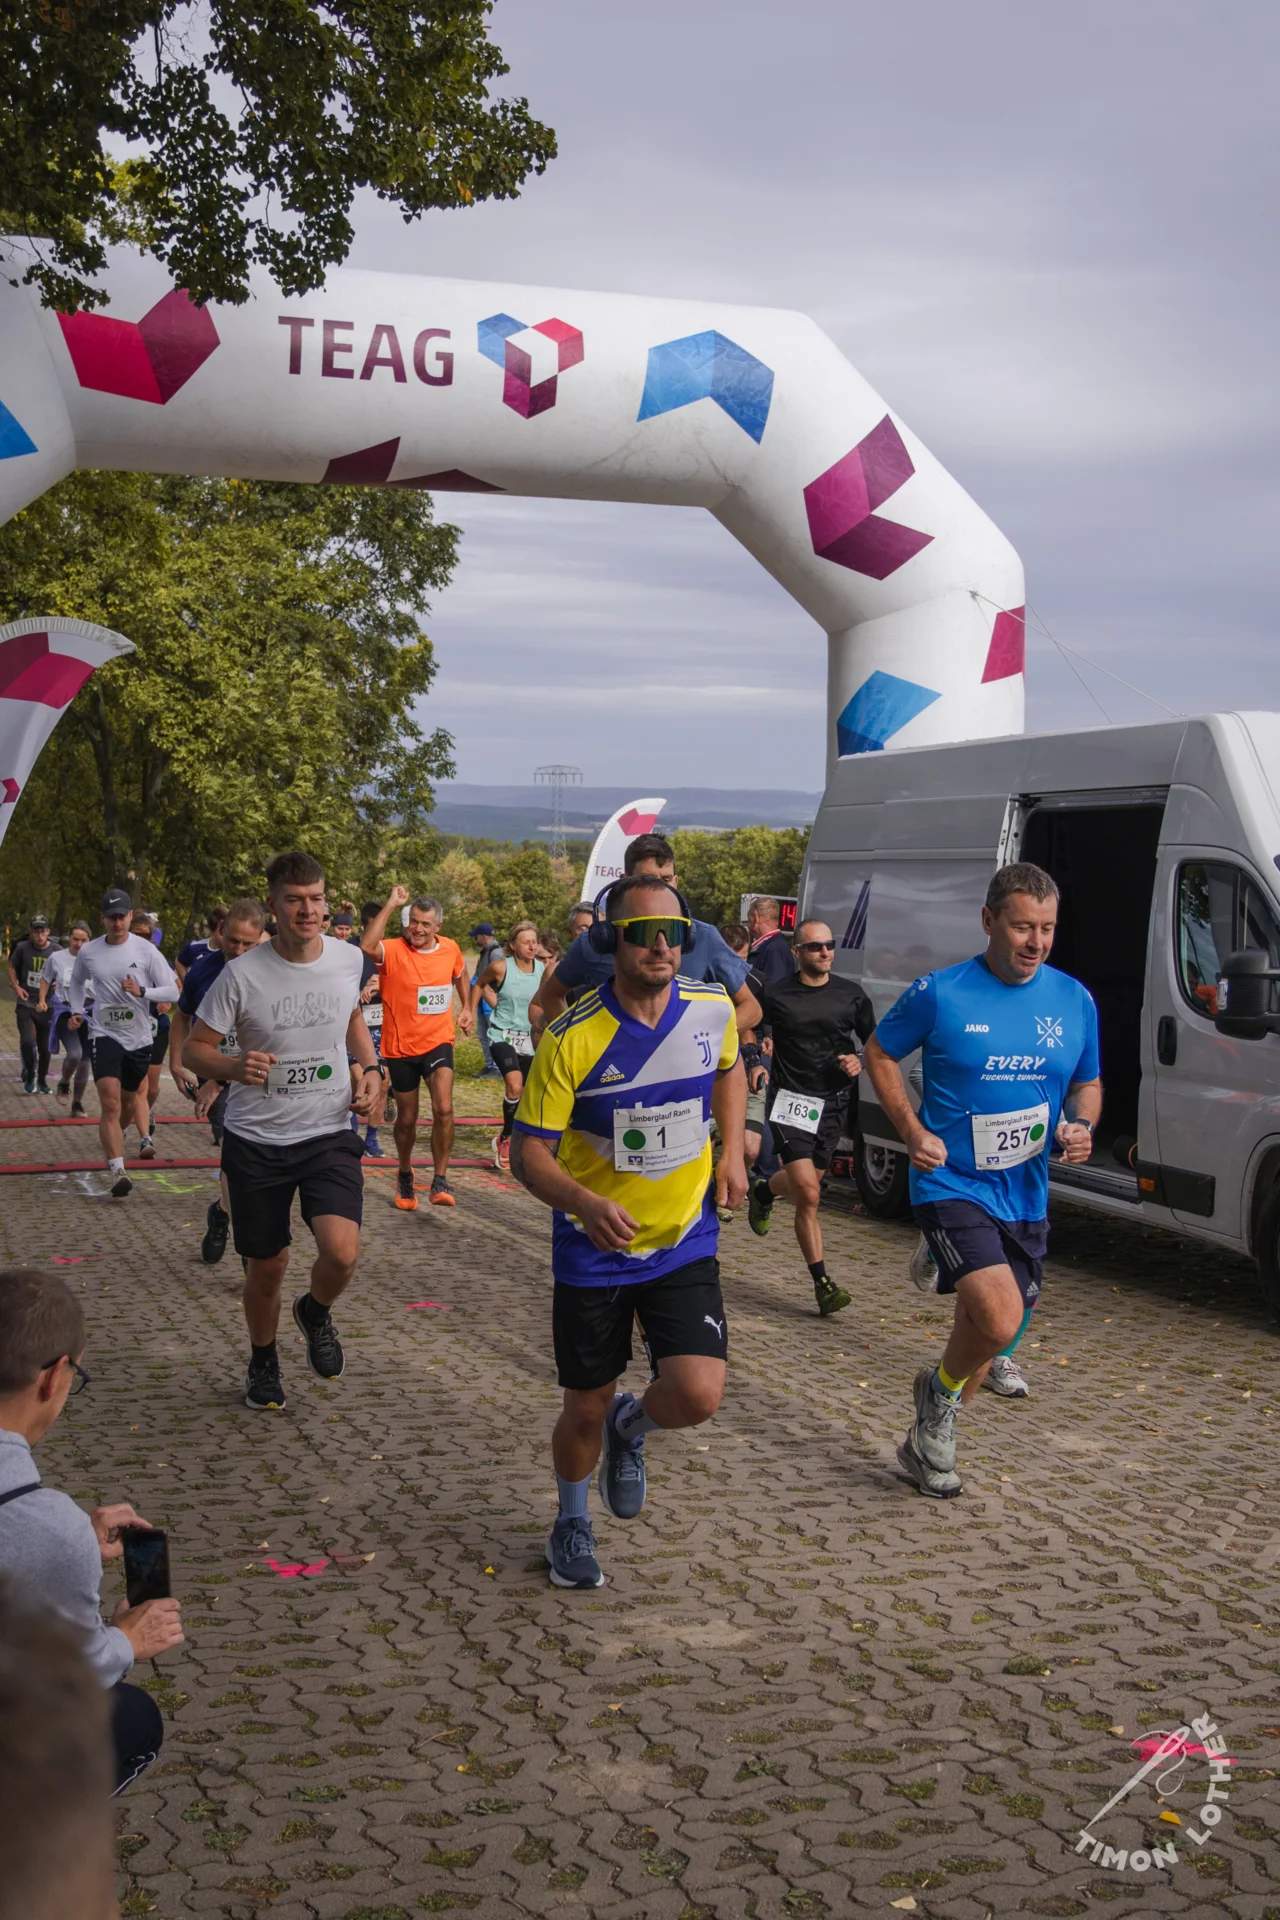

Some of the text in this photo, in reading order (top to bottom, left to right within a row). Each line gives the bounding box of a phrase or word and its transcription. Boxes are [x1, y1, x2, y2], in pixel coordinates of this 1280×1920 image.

[278, 315, 454, 387] TEAG
[595, 866, 622, 878] TEAG
[781, 904, 797, 928] 14
[428, 994, 445, 1006] 238
[109, 1011, 125, 1021] 154
[964, 1024, 990, 1033] JAKO
[228, 1035, 238, 1047] 9
[512, 1037, 525, 1047] 127
[278, 1057, 310, 1066] Limberglauf
[985, 1055, 1046, 1071] EVERY
[287, 1066, 318, 1085] 237
[600, 1073, 625, 1083] adidas
[980, 1074, 1015, 1082] FUCKING
[629, 1108, 691, 1123] Limberglauf Ranis
[787, 1102, 809, 1119] 163
[985, 1112, 1039, 1127] Limberglauf Ranis
[657, 1126, 666, 1149] 1
[996, 1126, 1031, 1152] 257
